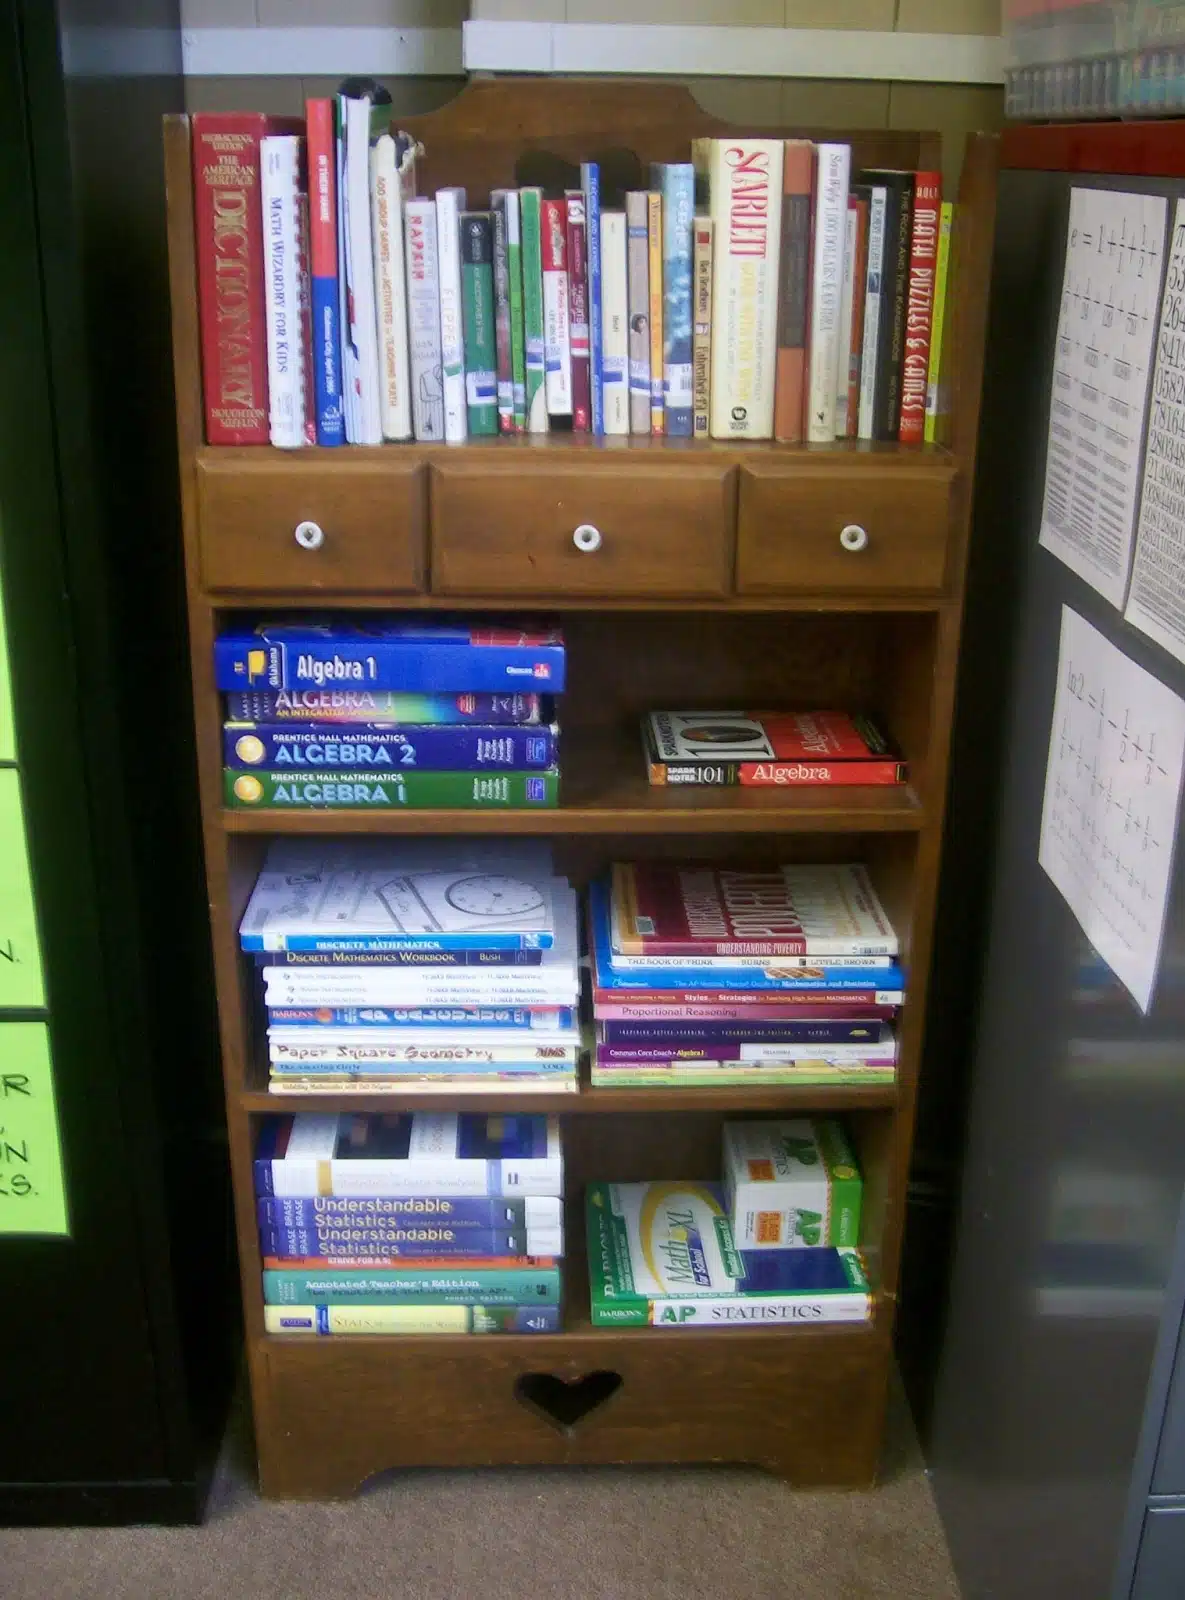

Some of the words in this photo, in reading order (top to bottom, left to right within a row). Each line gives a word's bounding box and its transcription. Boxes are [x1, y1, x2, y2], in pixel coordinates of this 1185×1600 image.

[217, 155, 238, 165] THE
[203, 164, 256, 176] AMERICAN
[724, 147, 769, 259] SCARLETT
[270, 196, 283, 236] MATH
[912, 208, 936, 257] MATH
[408, 215, 424, 280] NAPKIN
[271, 240, 285, 308] WIZARDRY
[212, 187, 254, 408] DICTIONARY
[907, 267, 933, 333] PUZZLES
[275, 312, 286, 337] FOR
[906, 338, 929, 349] &
[902, 354, 927, 411] GAMES
[269, 647, 278, 685] Oklahoma
[297, 655, 364, 685] Algebra
[366, 656, 377, 678] 1
[275, 690, 375, 708] ALGEBRA
[273, 734, 316, 742] PRENTICE
[318, 734, 340, 742] HALL
[343, 734, 406, 742] MATHEMATICS
[274, 744, 393, 765] ALGEBRA
[399, 744, 417, 765] 2
[271, 774, 314, 782] PRENTICE
[316, 774, 338, 782] HALL
[340, 774, 403, 782] MATHEMATICS
[697, 767, 723, 782] 101
[752, 764, 831, 783] Algebra
[272, 784, 390, 804] ALGEBRA
[398, 784, 407, 804] 1
[368, 941, 442, 949] MATHEMATICS
[716, 942, 772, 954] UNDERSTANDING
[773, 942, 803, 954] POVERTY
[286, 952, 329, 962] DISCRETE
[333, 952, 396, 962] MATHEMATICS
[400, 952, 456, 961] WORKBOOK
[480, 953, 501, 961] BUSH
[718, 994, 757, 1002] Strategies
[622, 1008, 682, 1018] Proportional
[686, 1008, 737, 1018] Reasoning
[277, 1045, 328, 1059] Paper
[336, 1045, 397, 1060] Square
[404, 1045, 493, 1063] Geometry
[284, 1200, 293, 1226] BRASE
[295, 1200, 304, 1226] BRASE
[314, 1197, 453, 1213] Understandable
[315, 1214, 397, 1228] Statistics
[796, 1209, 823, 1246] AP
[288, 1229, 297, 1254] BRASE
[299, 1229, 308, 1254] BRASE
[317, 1227, 454, 1241] Understandable
[319, 1242, 400, 1255] Statistics
[690, 1249, 706, 1273] School
[305, 1281, 367, 1289] Annotated
[370, 1280, 429, 1289] Teacher's
[432, 1280, 479, 1288] Edition
[660, 1306, 696, 1322] AP
[712, 1305, 823, 1320] STATISTICS
